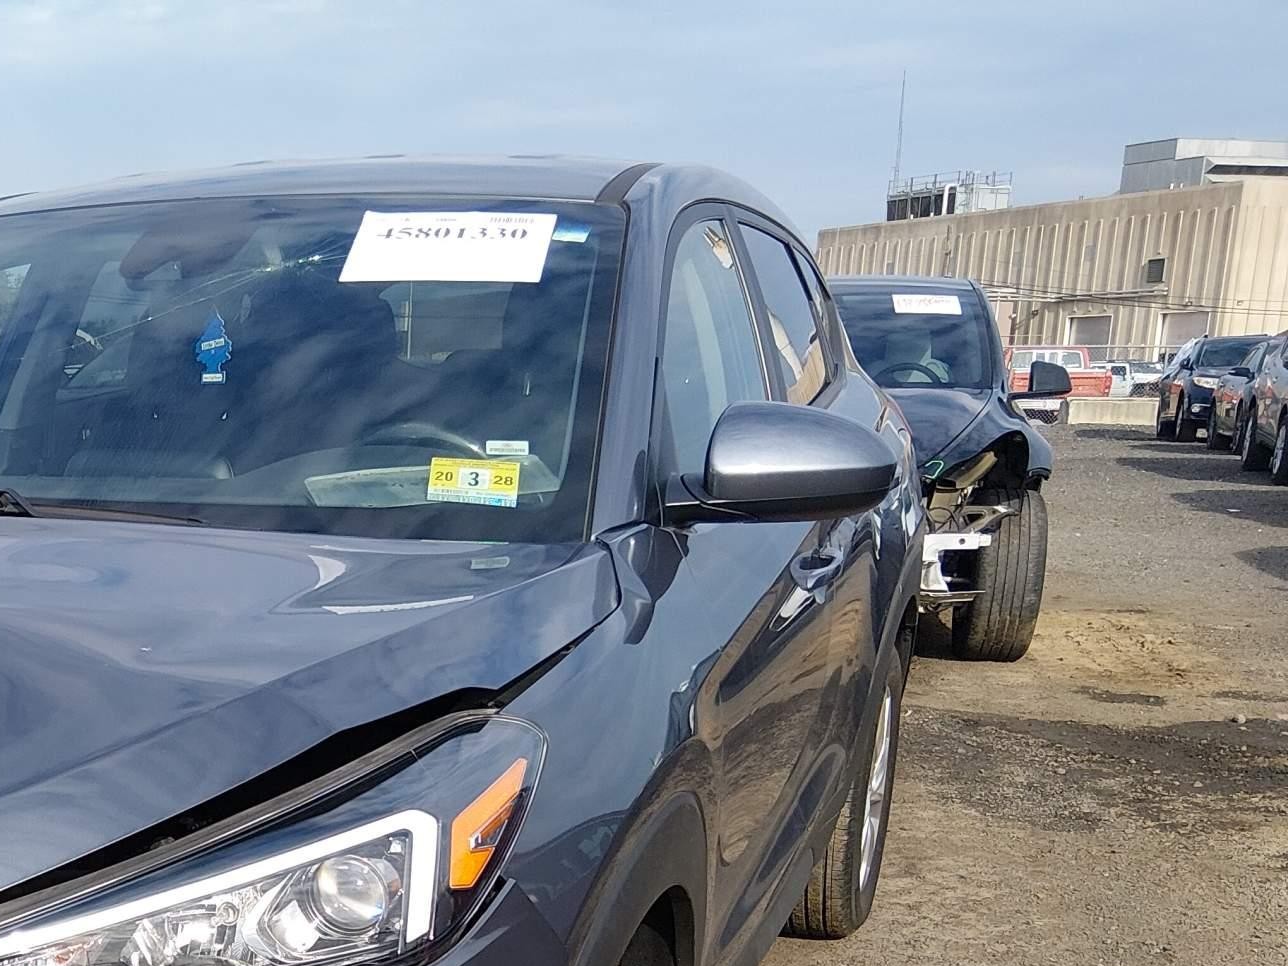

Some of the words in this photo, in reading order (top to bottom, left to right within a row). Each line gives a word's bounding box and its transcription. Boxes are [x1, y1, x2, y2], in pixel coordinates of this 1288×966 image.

[376, 227, 528, 240] 45801330
[435, 471, 453, 482] 20
[468, 471, 480, 487] 3
[493, 475, 514, 486] 28
